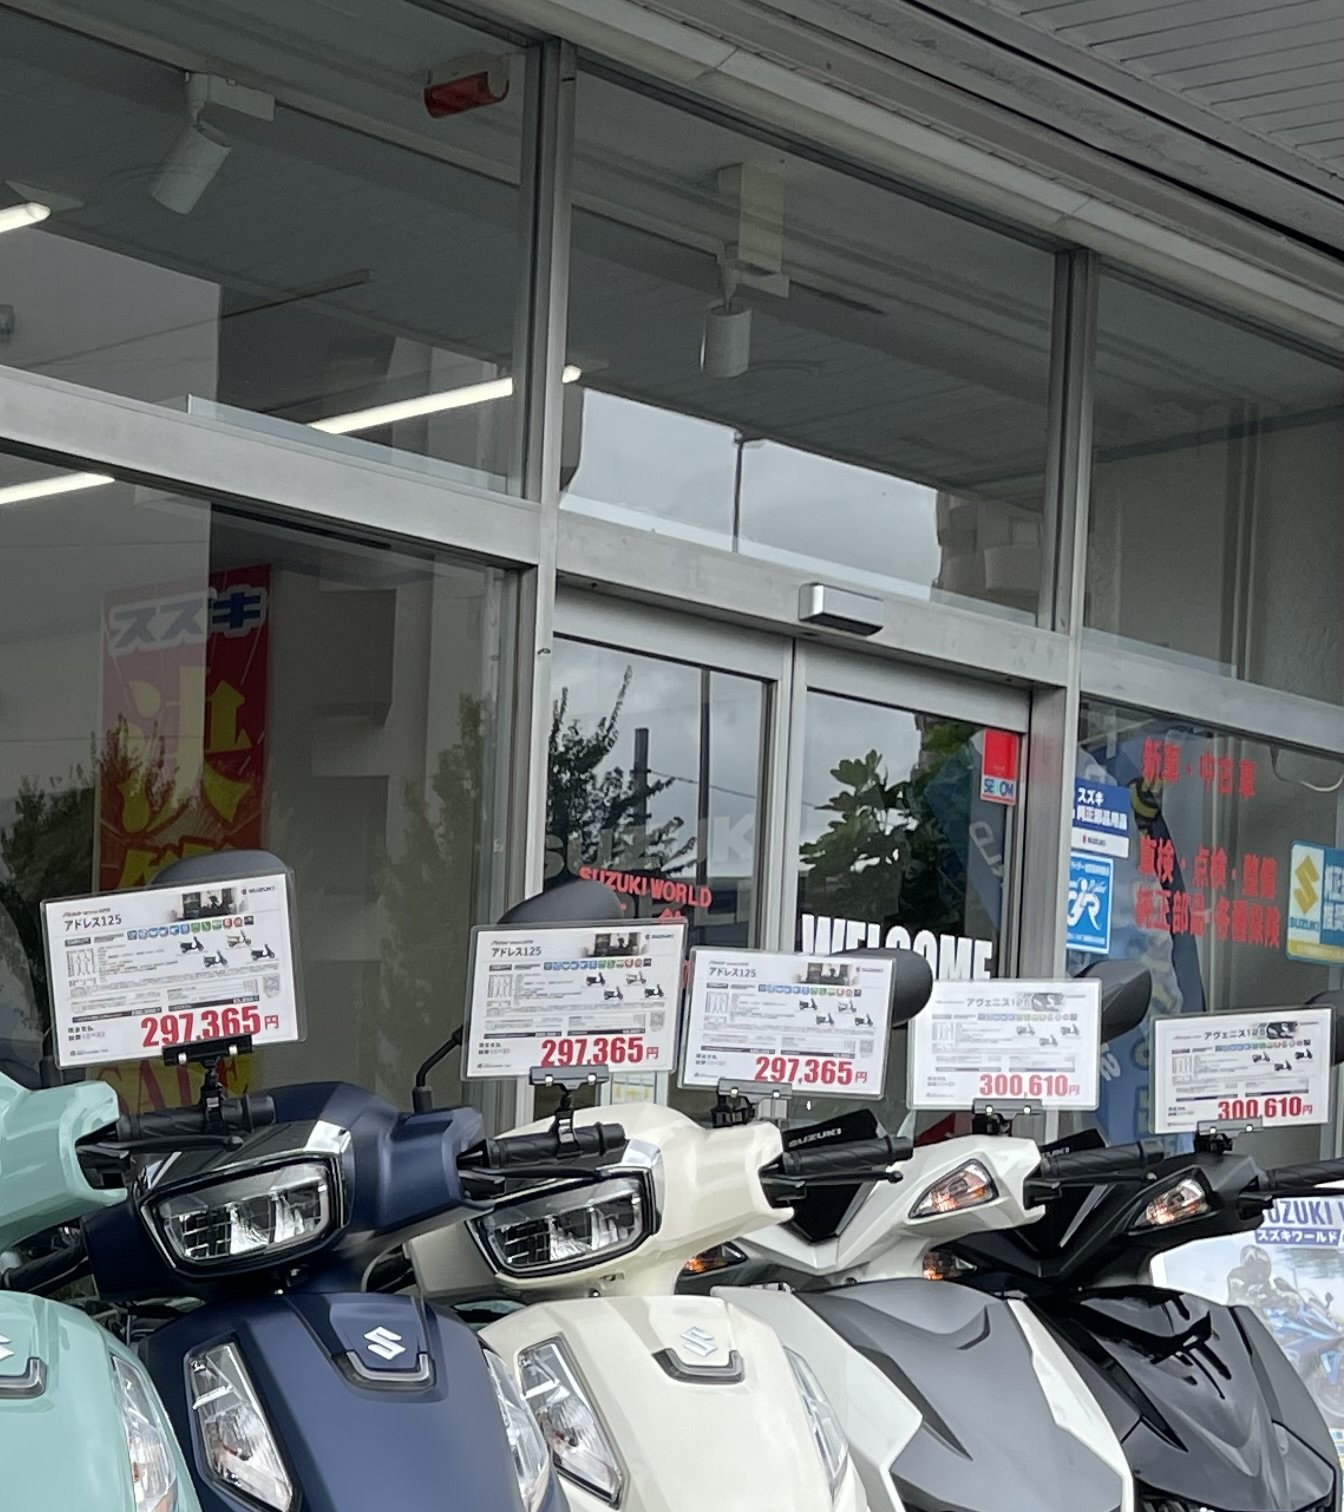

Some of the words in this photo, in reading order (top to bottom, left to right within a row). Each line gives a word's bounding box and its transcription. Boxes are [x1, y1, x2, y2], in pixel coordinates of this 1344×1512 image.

[114, 591, 262, 649] スズキ
[649, 878, 712, 909] WORLD
[1262, 1200, 1334, 1226] UZUKI
[1257, 1228, 1338, 1243] スズキワールド
